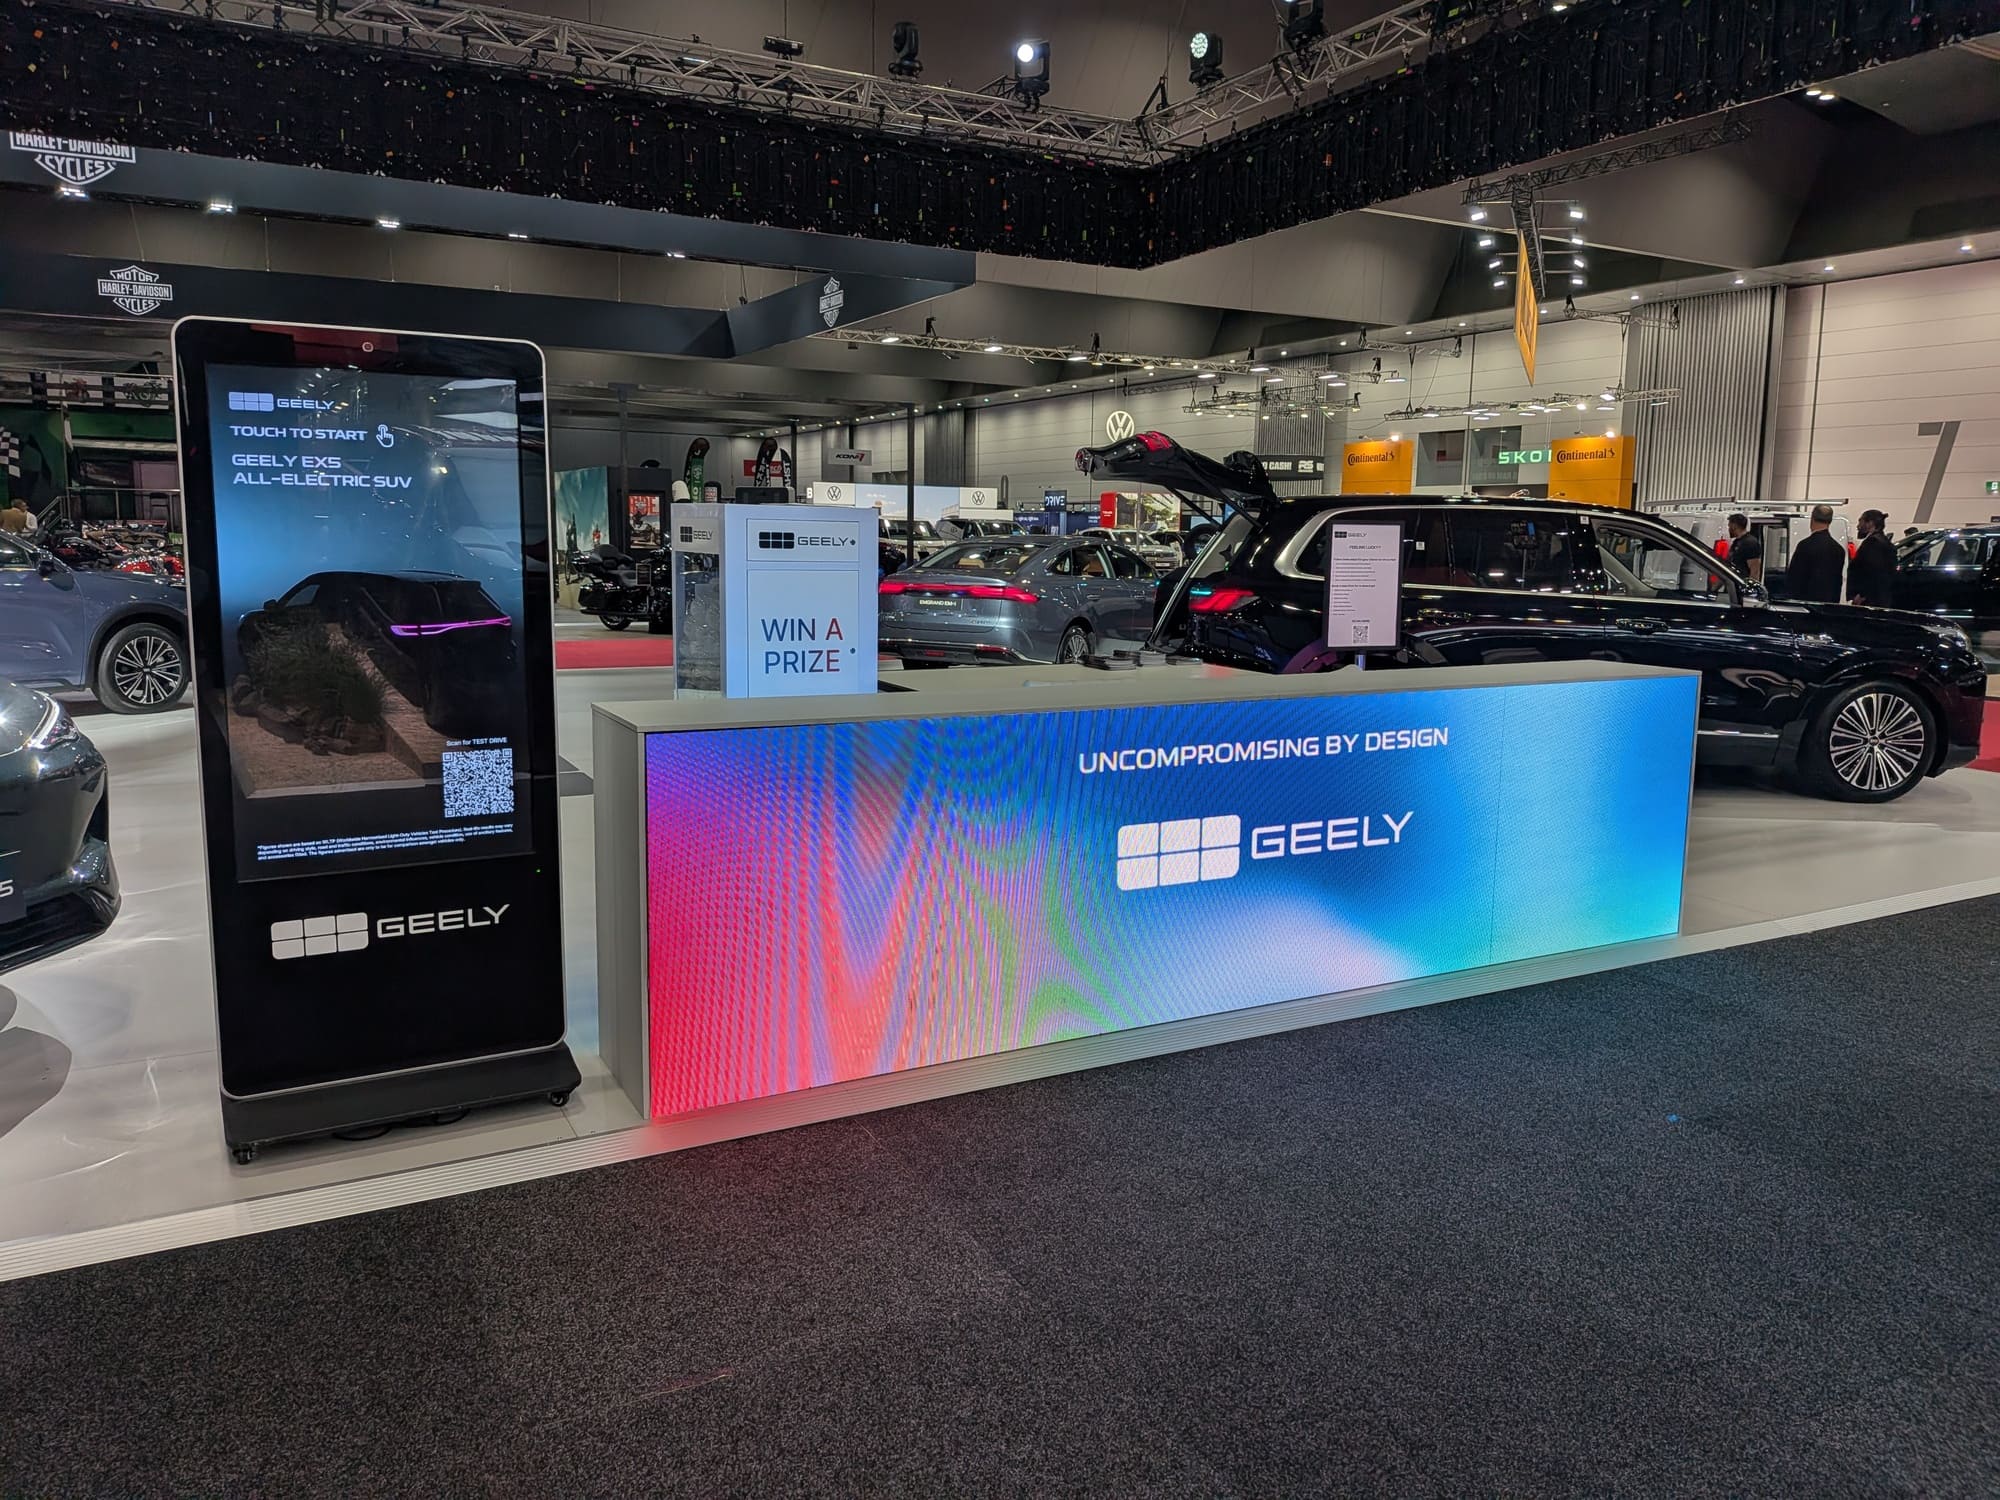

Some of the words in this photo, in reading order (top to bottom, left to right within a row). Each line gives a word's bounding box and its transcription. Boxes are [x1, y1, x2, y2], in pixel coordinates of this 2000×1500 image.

[16, 132, 130, 158] HARLEY-DAVIDSON
[44, 155, 105, 180] CYCLES
[116, 268, 153, 283] MOTOR
[101, 282, 170, 298] HARLEY-DAVIDSON
[118, 298, 155, 313] CYCLES
[277, 398, 334, 410] GEELY
[229, 425, 286, 438] TOUCH
[289, 428, 313, 439] TO
[315, 428, 368, 441] START
[232, 454, 298, 467] GEELY
[301, 456, 342, 469] EX5
[1347, 452, 1388, 466] Continental
[1556, 448, 1607, 463] Continental
[1912, 420, 1962, 523] 7
[233, 472, 371, 487] ALL-ELECTRIC
[374, 475, 412, 489] SUV
[1045, 496, 1065, 506] DRIVE
[693, 530, 713, 540] GEELY
[797, 536, 849, 546] GEELY
[761, 618, 816, 642] WIN
[825, 618, 843, 641] A
[765, 650, 840, 674] PRIZE
[1079, 736, 1320, 774] UNCOMPROMISING
[1325, 734, 1359, 755] BY
[1365, 727, 1449, 752] DESIGN
[1250, 811, 1414, 860] GEELY
[377, 903, 510, 938] GEELY
